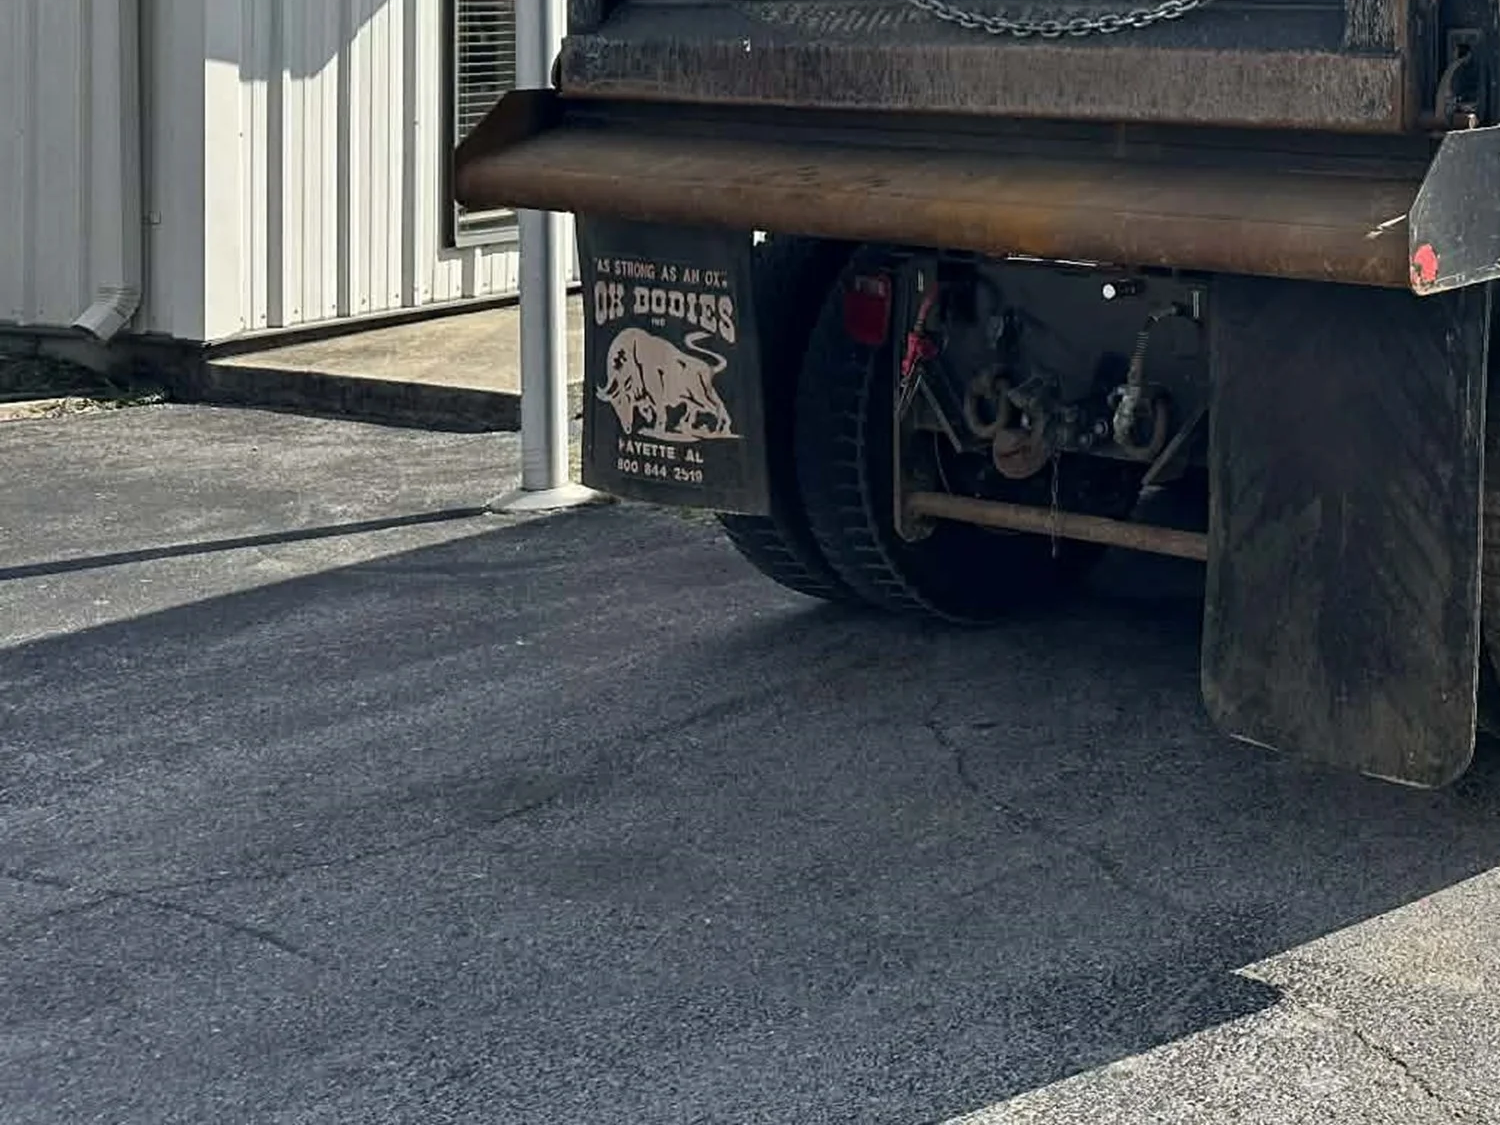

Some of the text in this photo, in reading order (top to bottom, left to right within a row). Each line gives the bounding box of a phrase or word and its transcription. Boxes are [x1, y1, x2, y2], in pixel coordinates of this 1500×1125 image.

[614, 260, 656, 280] STRONG
[661, 265, 677, 283] AS
[683, 268, 699, 284] AN
[595, 280, 736, 343] OX BODIES
[618, 438, 704, 464] FAYETTE AL
[617, 457, 639, 474] 800
[644, 462, 667, 478] 844
